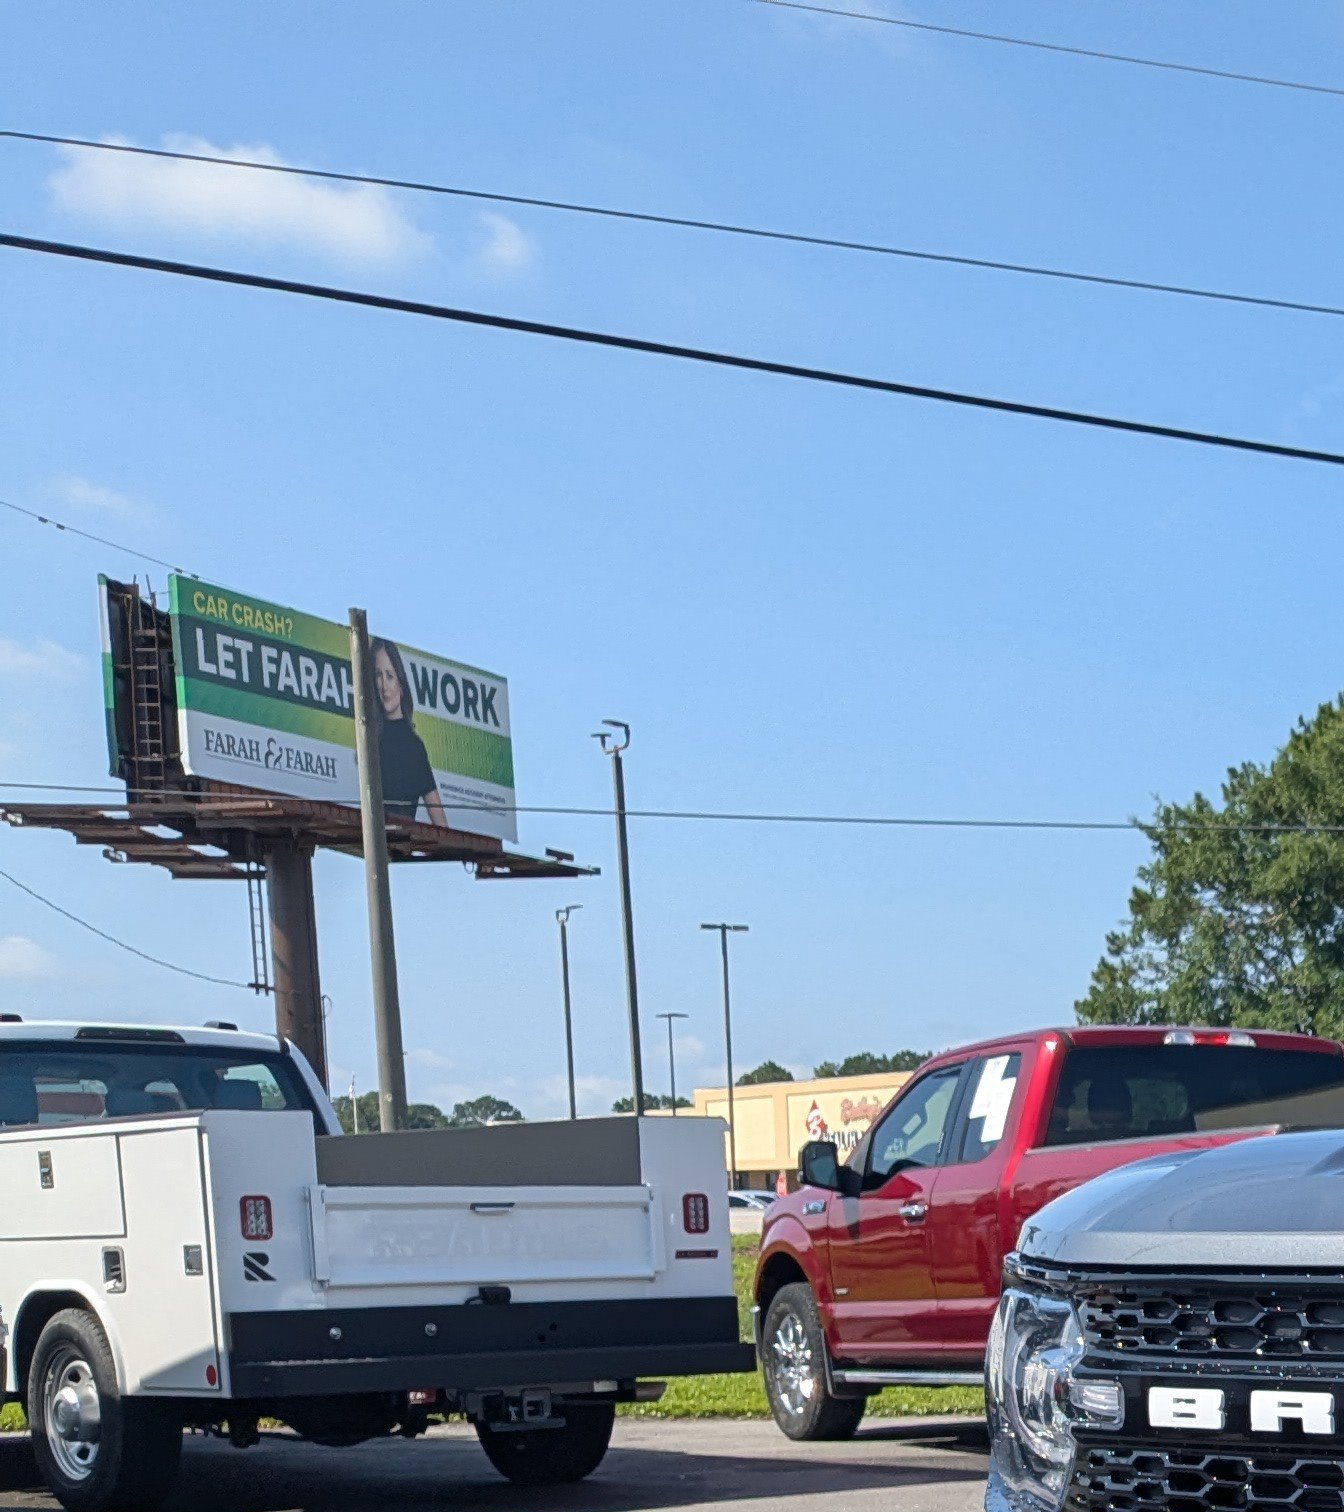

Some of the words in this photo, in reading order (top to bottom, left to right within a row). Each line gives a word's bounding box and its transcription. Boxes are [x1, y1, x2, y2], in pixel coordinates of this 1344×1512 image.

[193, 591, 228, 621] CAR
[231, 602, 293, 638] CRASH?
[196, 627, 253, 683] LET
[410, 662, 499, 727] WORK
[204, 728, 261, 762] FARAH
[285, 747, 337, 778] FARAH
